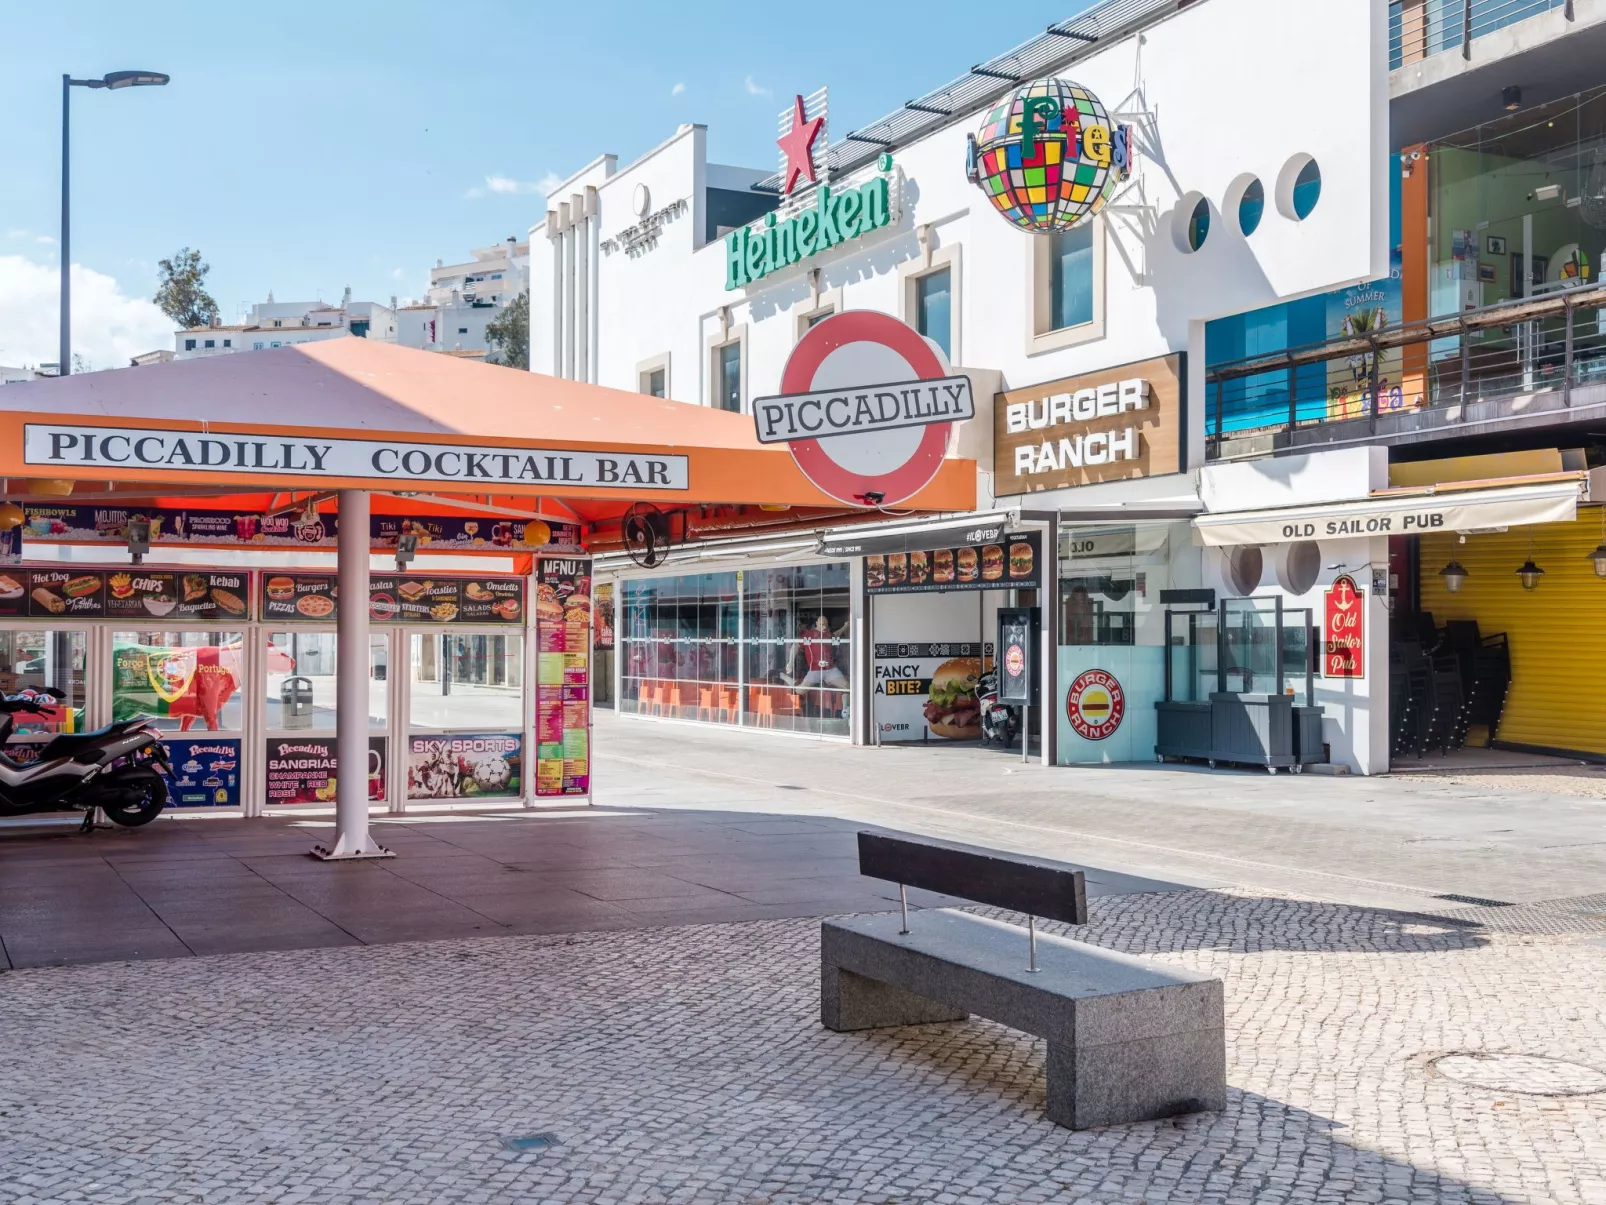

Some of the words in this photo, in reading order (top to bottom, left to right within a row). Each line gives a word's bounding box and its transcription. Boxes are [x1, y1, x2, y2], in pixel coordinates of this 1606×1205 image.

[725, 176, 890, 291] Heineken
[1345, 292, 1385, 309] SUMMER
[762, 384, 966, 436] PICCADILLY
[1006, 378, 1150, 434] BURGER
[1015, 427, 1139, 476] RANCH
[48, 432, 333, 471] PICCADILLY
[371, 448, 583, 482] COCKTAIL
[596, 458, 671, 485] BAR
[25, 508, 76, 517] FISHBOWLS
[95, 510, 128, 524] MOJITOS
[260, 517, 275, 526] WOO
[276, 518, 289, 527] WOO
[380, 522, 396, 531] Tiki
[427, 523, 443, 533] Tiki
[1283, 524, 1315, 538] OLD
[1326, 517, 1392, 535] SAILOR
[1403, 513, 1444, 529] PUB
[544, 560, 576, 575] MENU
[33, 574, 49, 583] Hot
[51, 572, 70, 582] Dog
[210, 576, 240, 588] Kebab
[132, 578, 163, 592] CHIPS
[296, 583, 329, 592] Burgers
[369, 581, 393, 590] astas
[426, 586, 457, 595] Toasties
[107, 600, 142, 609] VEGETARIAN
[180, 603, 216, 612] Baguettes
[269, 601, 295, 613] PIZZAS
[402, 604, 430, 613] STARTERS
[1331, 612, 1357, 632] Old
[1328, 633, 1361, 653] Sailor
[117, 658, 144, 670] Força
[1331, 655, 1357, 673] Pub
[875, 665, 920, 678] FANCY
[875, 682, 884, 694] A
[887, 681, 921, 694] BITE?
[1070, 674, 1121, 704] BURGER
[1071, 712, 1120, 737] RANCH
[414, 740, 446, 753] SKY
[451, 740, 516, 752] SPORTS
[269, 759, 337, 769] SANGRIAS
[269, 771, 328, 780] CHAMPANHE
[269, 781, 299, 789] WHITE
[269, 788, 296, 798] ROSÉ
